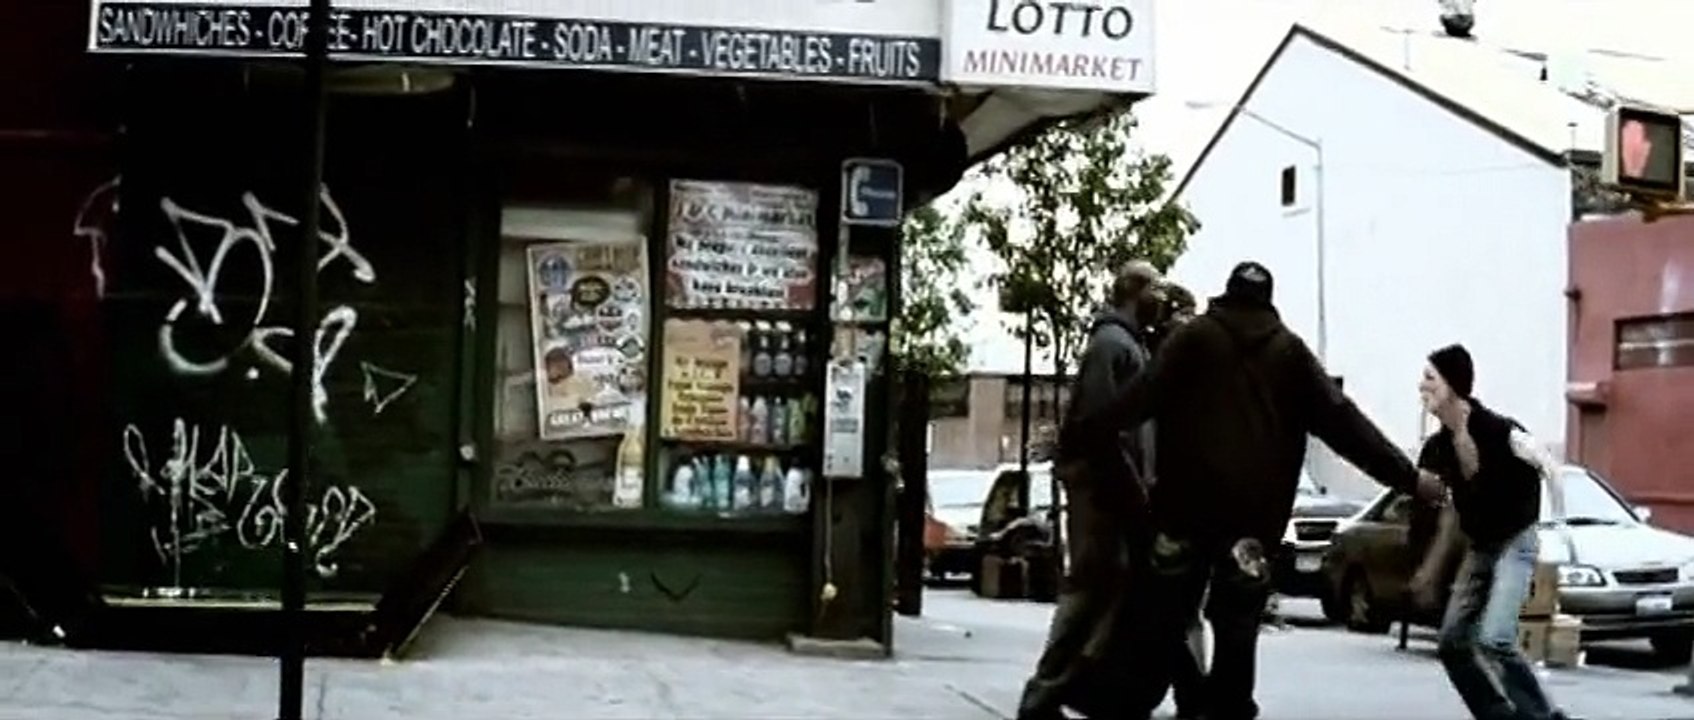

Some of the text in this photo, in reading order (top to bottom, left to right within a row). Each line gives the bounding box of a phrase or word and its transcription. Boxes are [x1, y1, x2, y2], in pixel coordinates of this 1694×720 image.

[988, 0, 1133, 40] LOTTO
[100, 6, 250, 46] SANDWHICHES
[362, 14, 407, 51] HOT
[411, 16, 537, 57] CHOCOLATE
[554, 22, 613, 61] SODA
[628, 28, 686, 65] MEAT
[701, 31, 832, 72] VEGETABLES
[848, 38, 921, 77] FRUITS
[964, 50, 1142, 81] MINIMARKET
